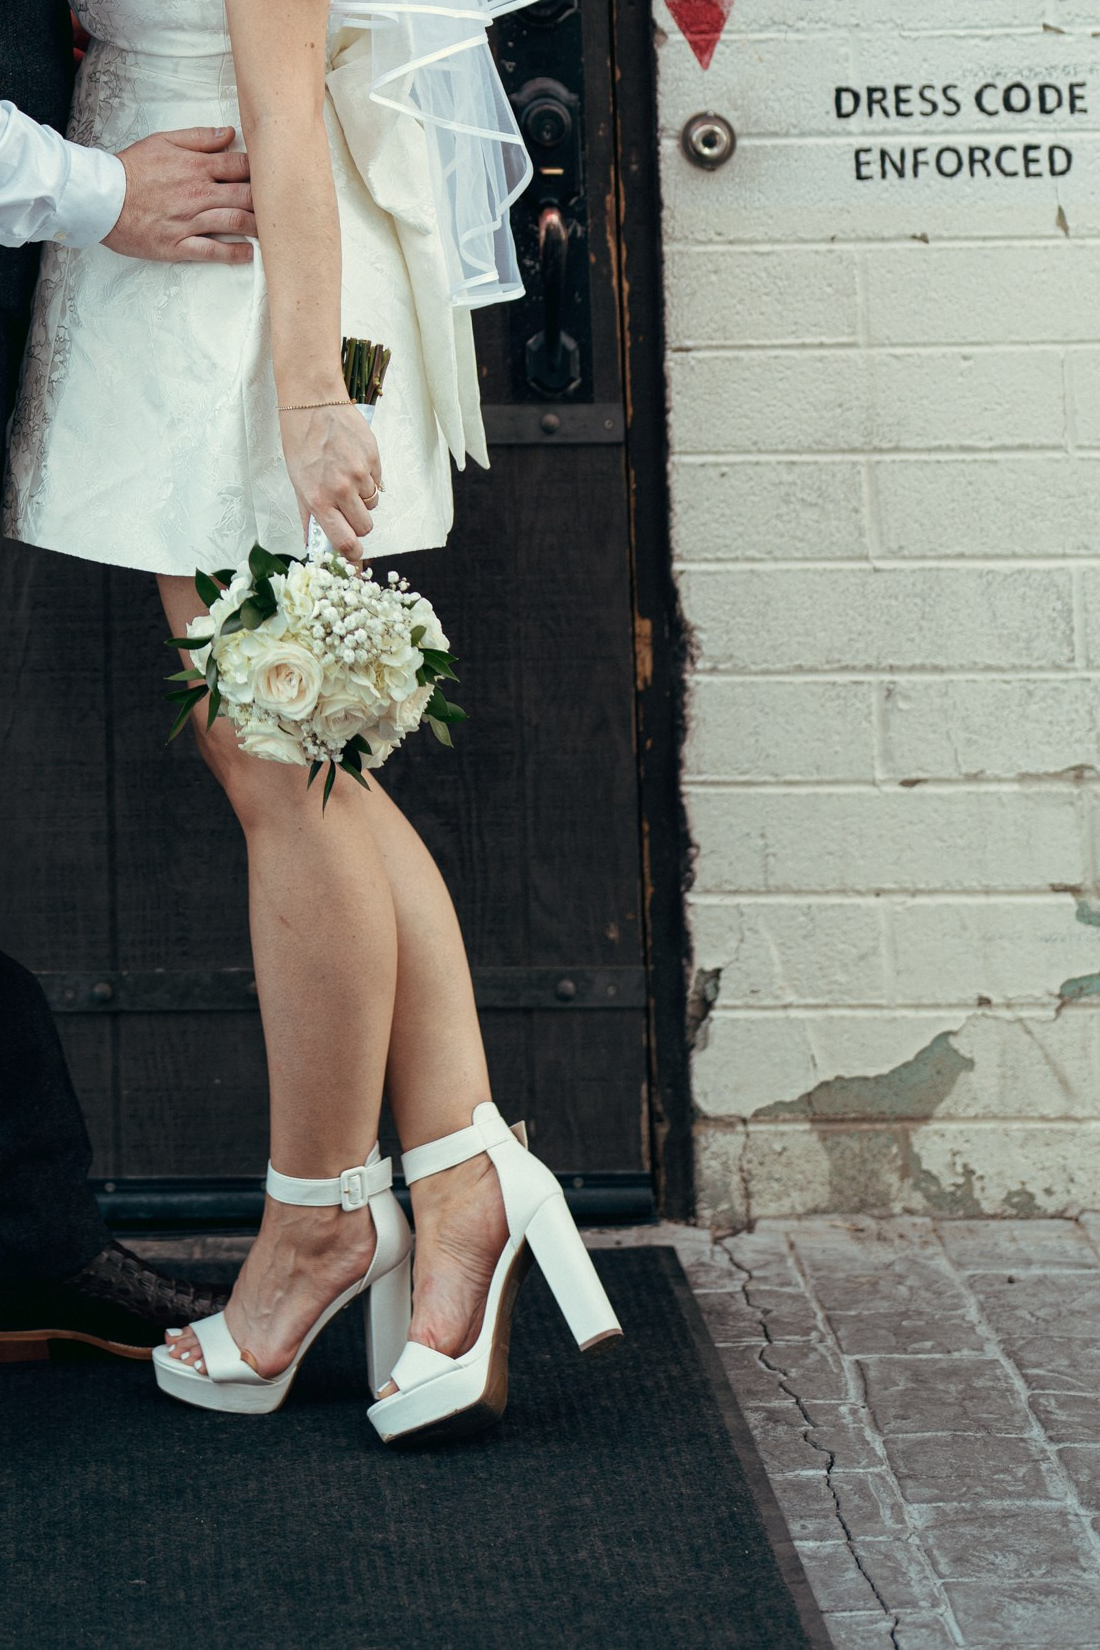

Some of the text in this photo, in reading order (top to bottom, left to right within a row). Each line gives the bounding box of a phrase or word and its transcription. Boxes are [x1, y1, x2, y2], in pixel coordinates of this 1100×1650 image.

[835, 82, 1087, 118] DRESS CODE
[855, 145, 1072, 180] ENFORCED
